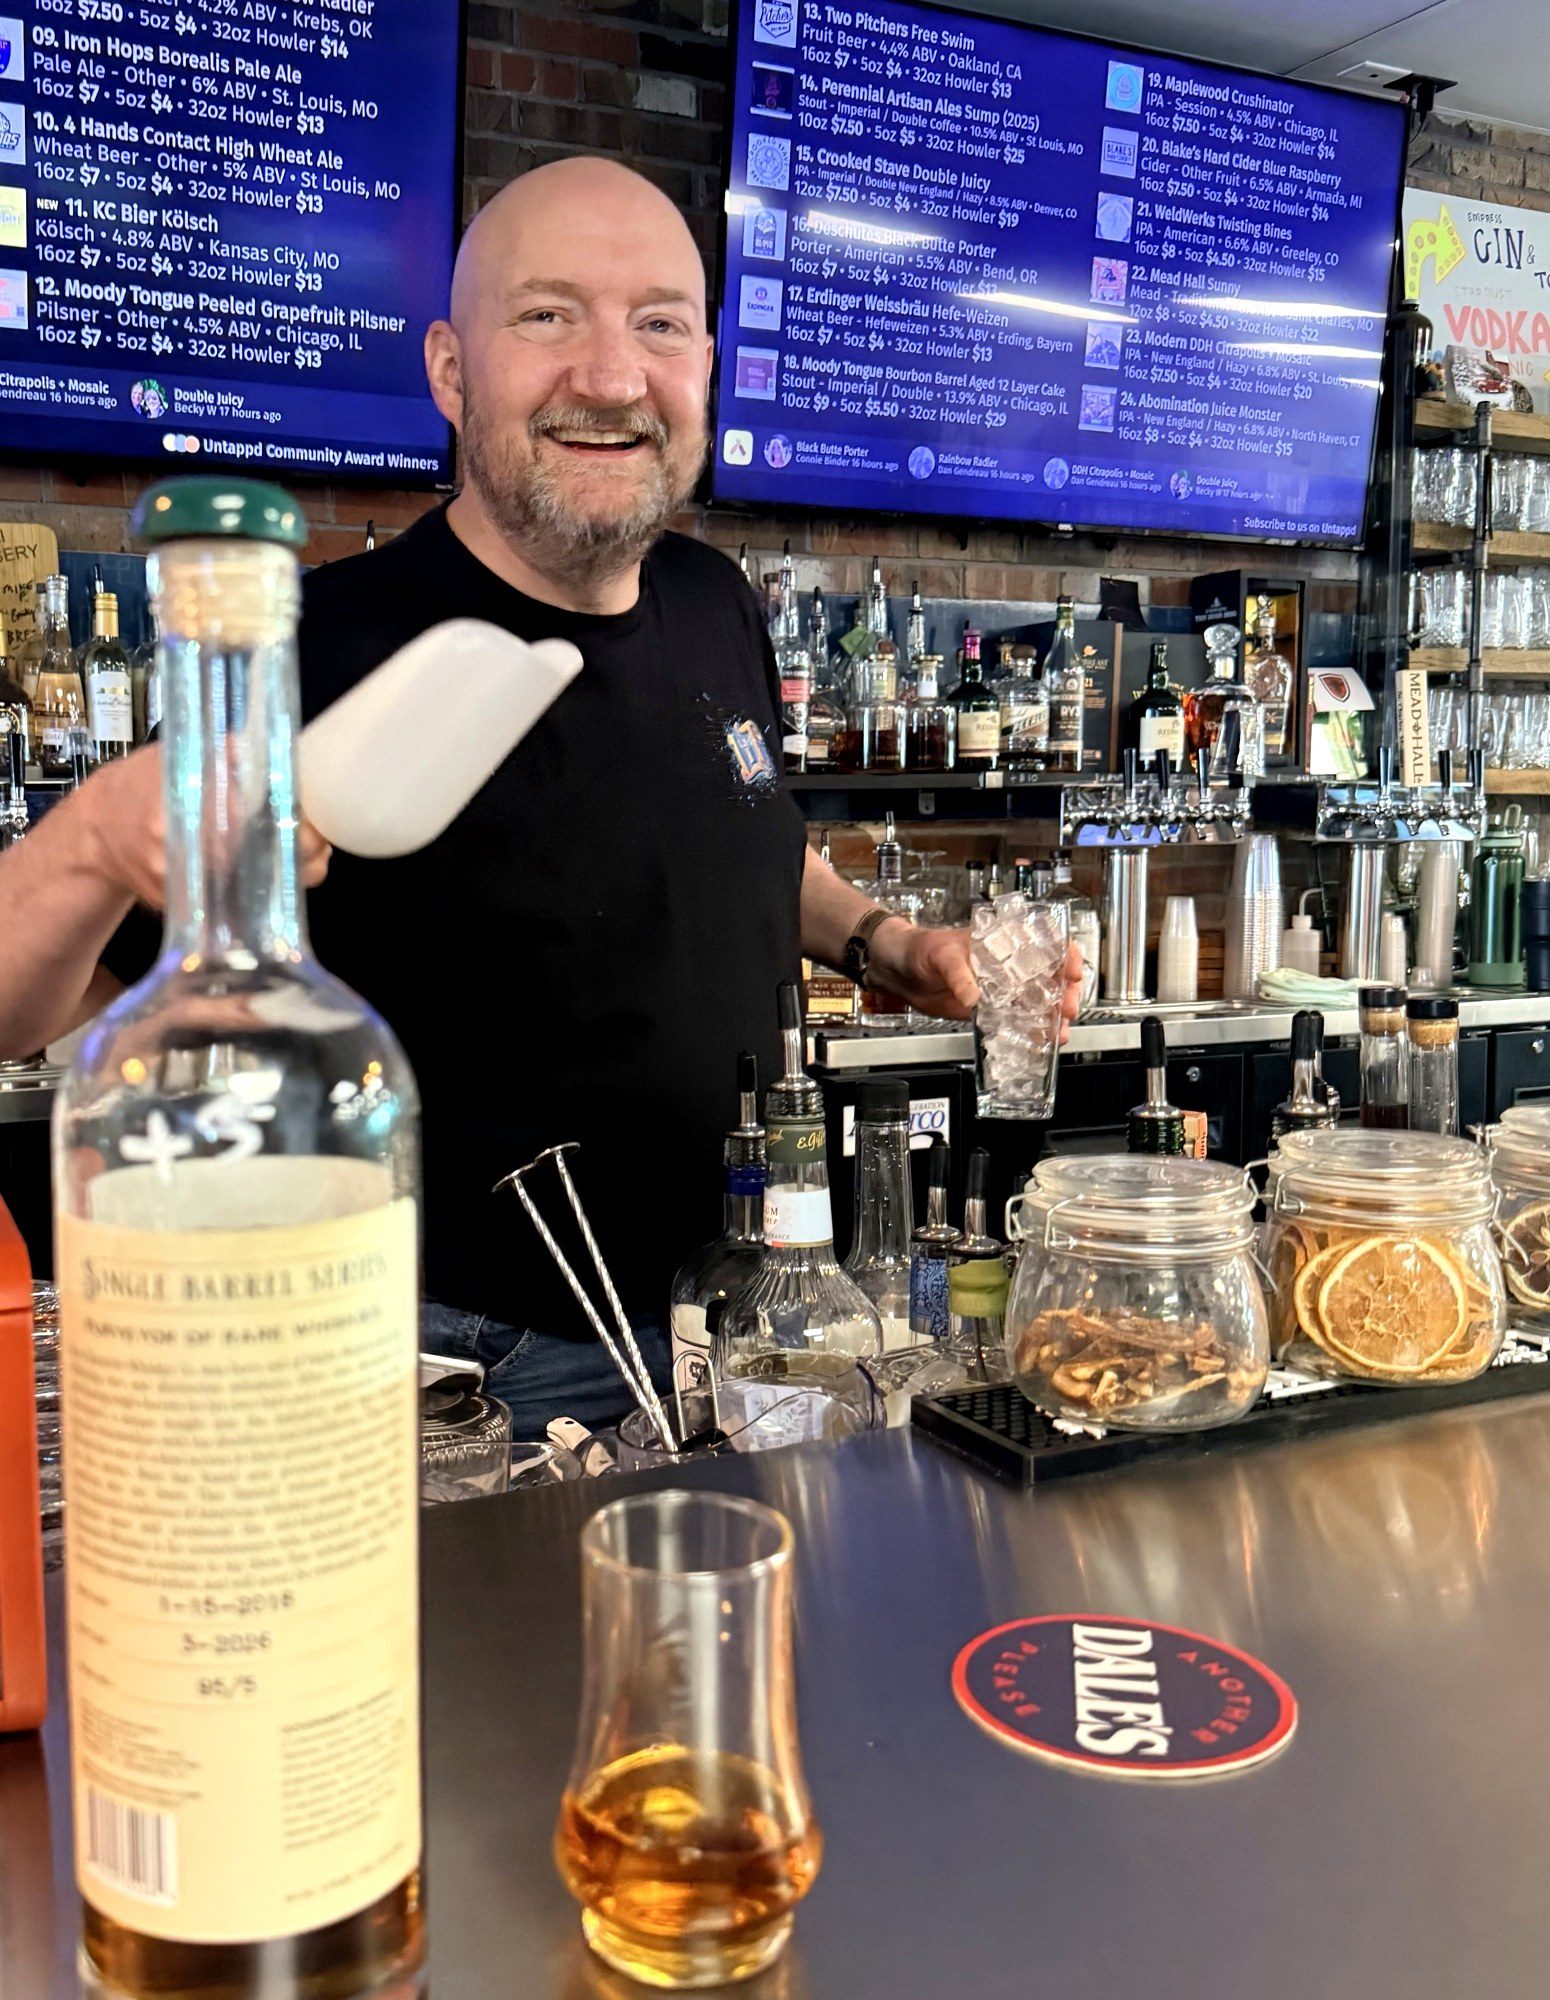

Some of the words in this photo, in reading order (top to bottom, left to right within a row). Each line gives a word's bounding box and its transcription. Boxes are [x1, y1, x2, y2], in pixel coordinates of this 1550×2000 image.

[803, 2, 821, 20] 13.
[824, 5, 852, 26] Two
[855, 12, 908, 38] Pitchers
[911, 23, 938, 44] Free
[940, 30, 974, 51] Swim
[32, 25, 59, 47] 09.
[64, 30, 101, 54] Iron
[107, 36, 154, 63] Hops
[159, 45, 229, 73] Borealis
[235, 57, 270, 79] Pale
[274, 63, 302, 84] Ale
[33, 51, 71, 73] Pale
[76, 58, 105, 78] Ale
[124, 65, 175, 89] Other
[191, 75, 218, 95] 6%
[223, 80, 256, 100] ABV
[272, 87, 293, 106] St.
[299, 91, 346, 116] Louis,
[352, 99, 378, 119] MO
[799, 73, 818, 91] 14.
[821, 76, 884, 103] Perennial
[886, 88, 932, 112] Artisan
[934, 97, 962, 117] Ales
[964, 104, 1000, 127] Sump
[1002, 109, 1039, 133] (2025)
[1147, 72, 1163, 88] 19.
[1164, 75, 1229, 102] Maplewood
[1231, 88, 1294, 114] Crushinator
[33, 110, 59, 132] 10.
[63, 114, 76, 134] 4
[80, 116, 138, 142] Hands
[142, 126, 210, 152] Contact
[215, 135, 253, 159] High
[259, 141, 313, 166] Wheat
[316, 150, 343, 170] Ale
[1161, 139, 1201, 160] Blake's
[1202, 147, 1230, 166] Hard
[1231, 153, 1261, 172] Cider
[1262, 158, 1286, 176] Blue
[1288, 164, 1341, 189] Raspberry
[33, 135, 92, 160] Wheat
[98, 143, 139, 166] Beer
[157, 152, 207, 174] Other
[223, 160, 248, 180] 5%
[252, 164, 285, 184] ABV
[300, 171, 318, 189] St
[323, 173, 369, 198] Louis,
[374, 180, 400, 199] MO
[796, 144, 814, 162] 15.
[816, 148, 871, 172] Crooked
[874, 157, 910, 177] Stave
[912, 163, 958, 185] Double
[960, 172, 991, 194] Juicy
[36, 197, 58, 211] NEW
[64, 197, 88, 217] 11.
[93, 199, 116, 220] KC
[121, 203, 158, 225] Bier
[162, 208, 218, 233] Kölsch
[1136, 200, 1152, 217] 21.
[1154, 203, 1215, 228] WeldWerks
[1216, 214, 1261, 238] Twisting
[1263, 222, 1292, 240] Bines
[1467, 212, 1503, 224] EMPRESS
[35, 218, 94, 242] Kölsch
[112, 228, 154, 248] 4.8%
[158, 233, 193, 253] ABV
[209, 238, 269, 262] Kansas
[273, 246, 308, 269] City,
[313, 250, 339, 270] MO
[1474, 228, 1524, 269] GIN
[35, 276, 60, 295] 12.
[64, 278, 126, 306] Moody
[129, 284, 194, 311] Tongue
[198, 292, 255, 316] Peeled
[260, 300, 345, 326] Grapefruit
[350, 308, 405, 332] Pilsner
[1131, 264, 1148, 281] 22.
[1149, 267, 1181, 286] Mead
[1182, 272, 1205, 289] Hall
[1206, 277, 1240, 297] Sunny
[36, 300, 99, 323] Pilsner
[117, 309, 167, 330] Other
[183, 316, 223, 335] 4.5%
[227, 320, 261, 339] ABV
[276, 325, 344, 350] Chicago,
[349, 332, 362, 350] IL
[787, 284, 803, 301] 17.
[806, 286, 862, 310] Erdinger
[864, 293, 929, 317] Weissbräu
[932, 303, 1008, 327] Hefe-Weizen
[1443, 304, 1550, 354] VODKA
[801, 355, 841, 376] Moody
[842, 360, 883, 380] Tongue
[885, 366, 932, 383] Bourbon
[934, 371, 967, 386] Barrel
[968, 375, 995, 392] Aged
[997, 378, 1009, 391] 12
[1010, 380, 1039, 396] Layer
[1040, 383, 1065, 397] Cake
[1509, 360, 1534, 376] NIC
[174, 388, 214, 404] Double
[216, 392, 244, 409] Juicy
[174, 401, 204, 417] Becky
[206, 404, 217, 415] W
[219, 406, 229, 416] 17
[231, 406, 261, 419] hours
[262, 410, 281, 423] ago
[1119, 390, 1136, 406] 24.
[1138, 393, 1209, 414] Abomination
[1210, 401, 1237, 417] Juice
[1238, 405, 1282, 421] Monster
[203, 438, 262, 459] Untappd
[265, 443, 342, 466] Community
[344, 450, 384, 466] Award
[387, 453, 439, 470] Winners
[1410, 673, 1422, 720] MEAD
[1412, 736, 1424, 784] HALL
[992, 1641, 1041, 1717] PLEASE
[1176, 1650, 1252, 1743] ANOTHER
